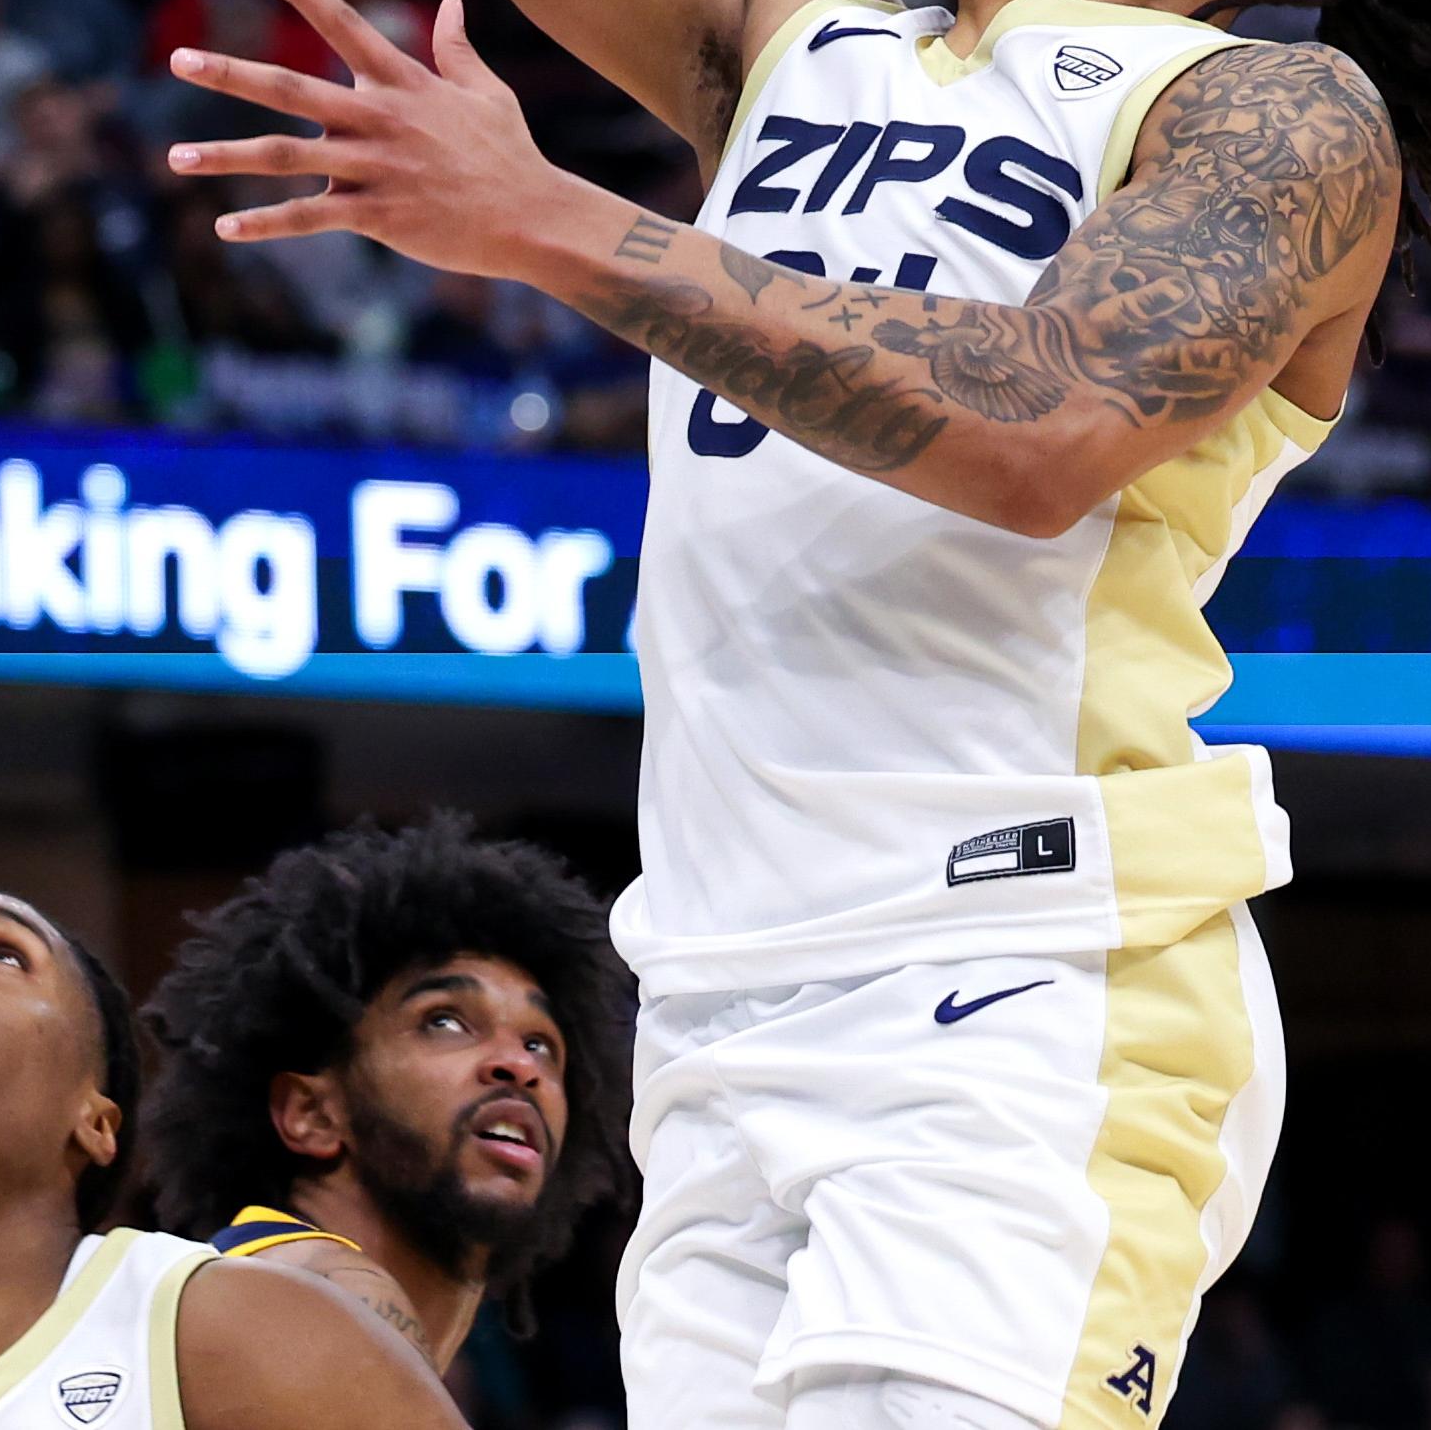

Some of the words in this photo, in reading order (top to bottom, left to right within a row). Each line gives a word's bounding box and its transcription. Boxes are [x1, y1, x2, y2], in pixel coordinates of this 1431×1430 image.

[728, 115, 1083, 260] ZIPS
[350, 479, 614, 656] For
[1037, 835, 1053, 856] L
[1106, 1345, 1155, 1416] A
